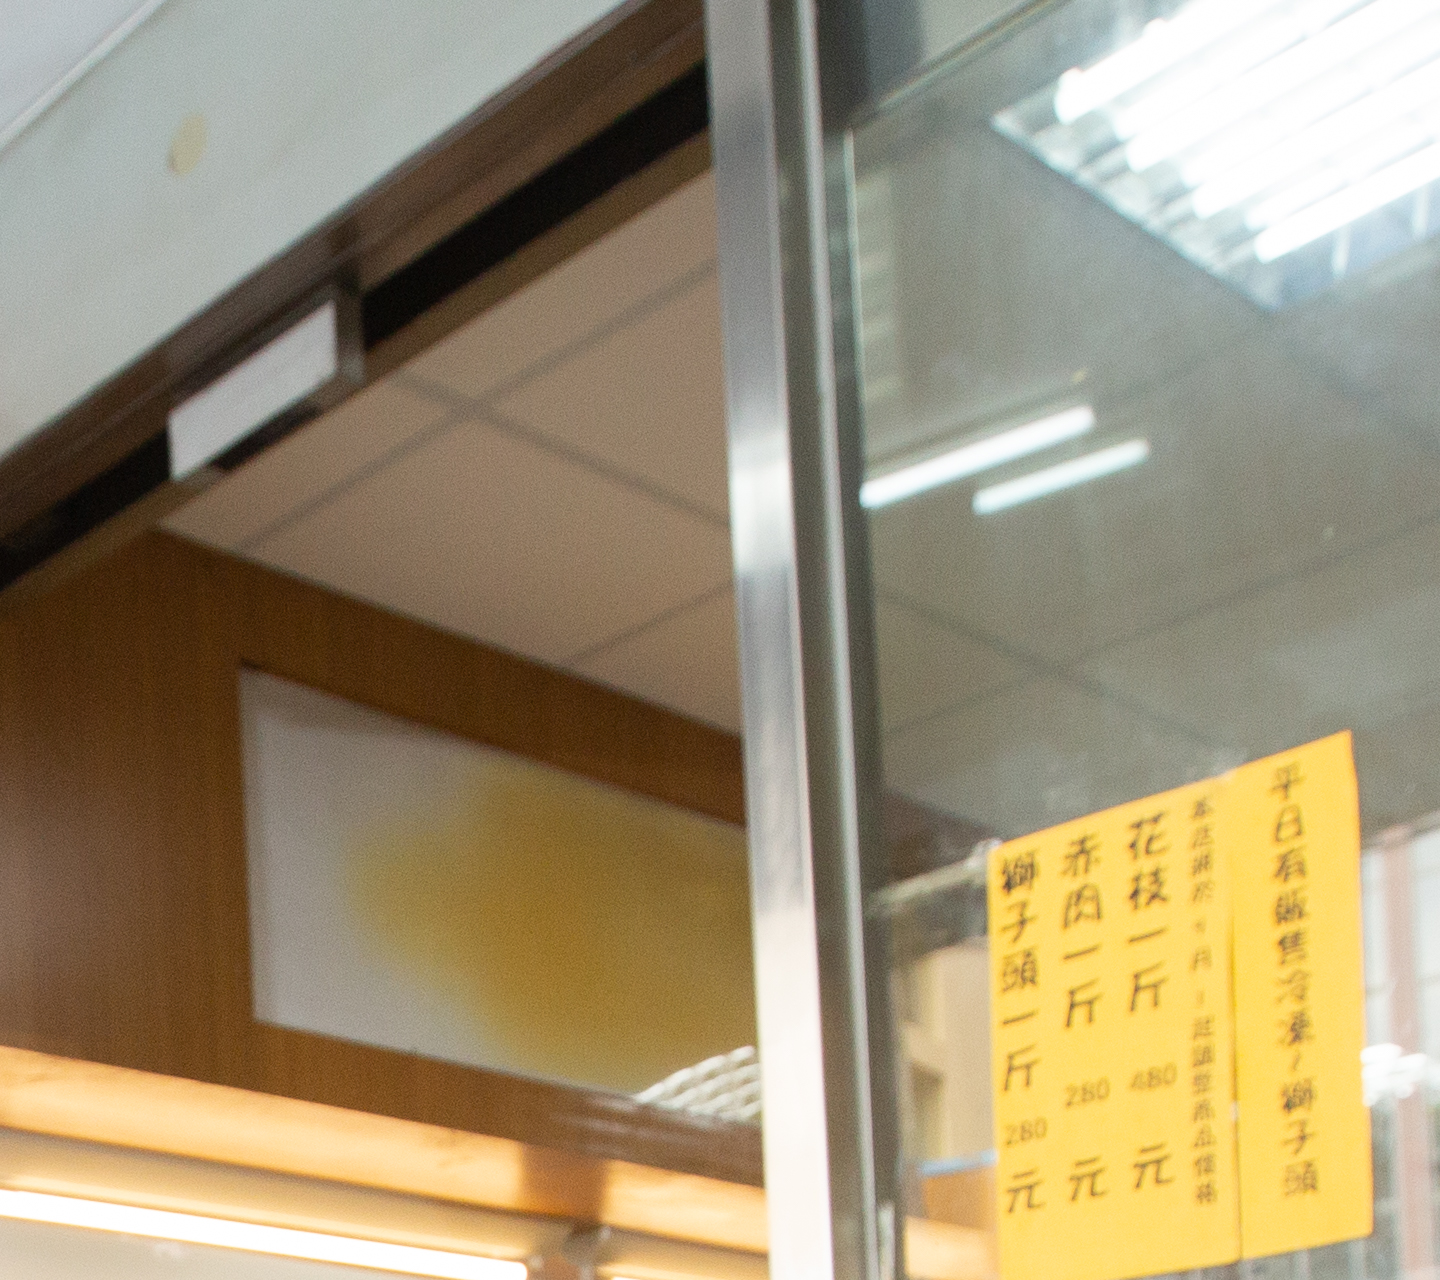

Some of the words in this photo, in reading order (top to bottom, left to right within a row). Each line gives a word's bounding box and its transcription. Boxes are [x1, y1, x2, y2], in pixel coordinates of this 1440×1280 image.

[1128, 811, 1172, 1012] 花枝一斤
[1001, 850, 1042, 1092] 獅子頭一斤
[1068, 1156, 1108, 1203] 元
[1133, 1141, 1175, 1190] 元
[1007, 1167, 1046, 1214] 元
